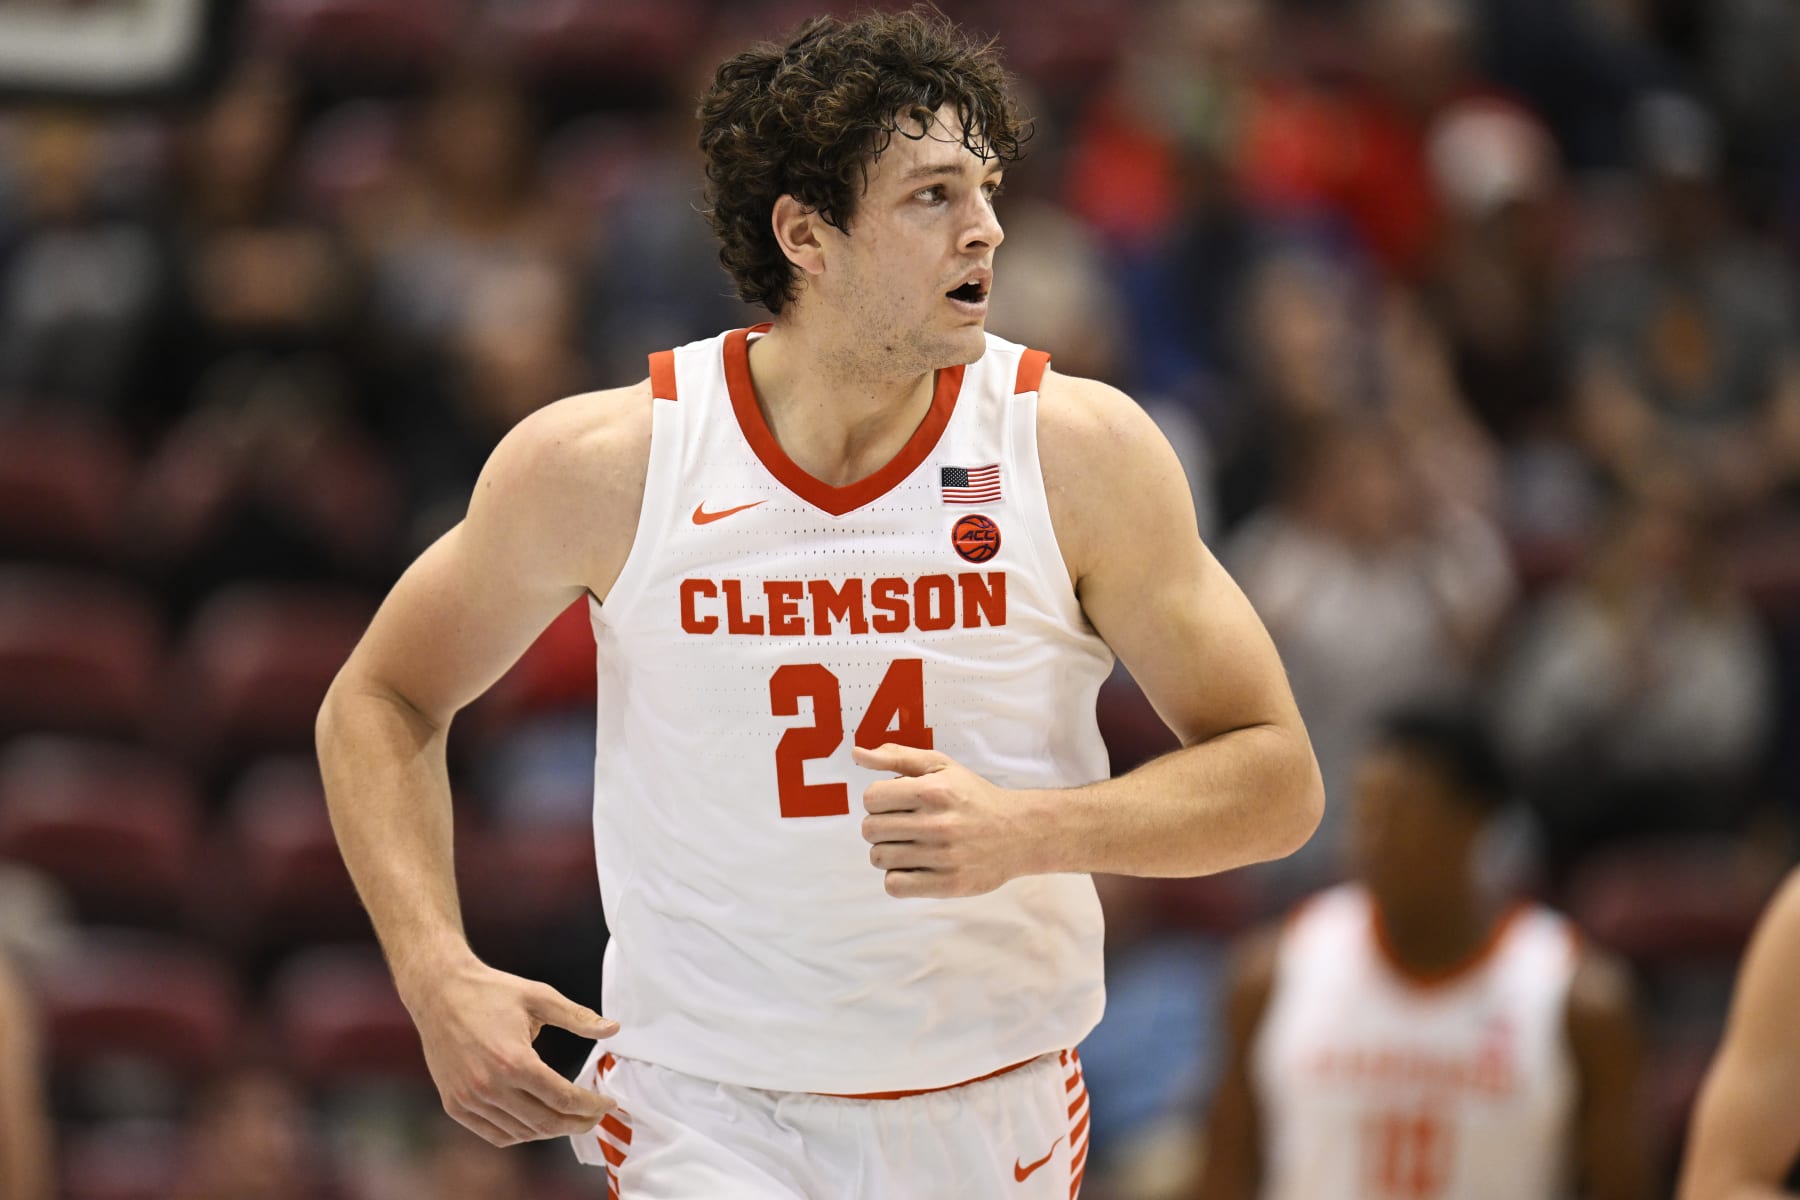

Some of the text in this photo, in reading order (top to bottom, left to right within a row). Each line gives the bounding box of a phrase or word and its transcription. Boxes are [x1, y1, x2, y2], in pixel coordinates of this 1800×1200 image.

[959, 530, 995, 541] ACC
[680, 571, 1007, 636] CLEMSON
[769, 658, 934, 818] 24
